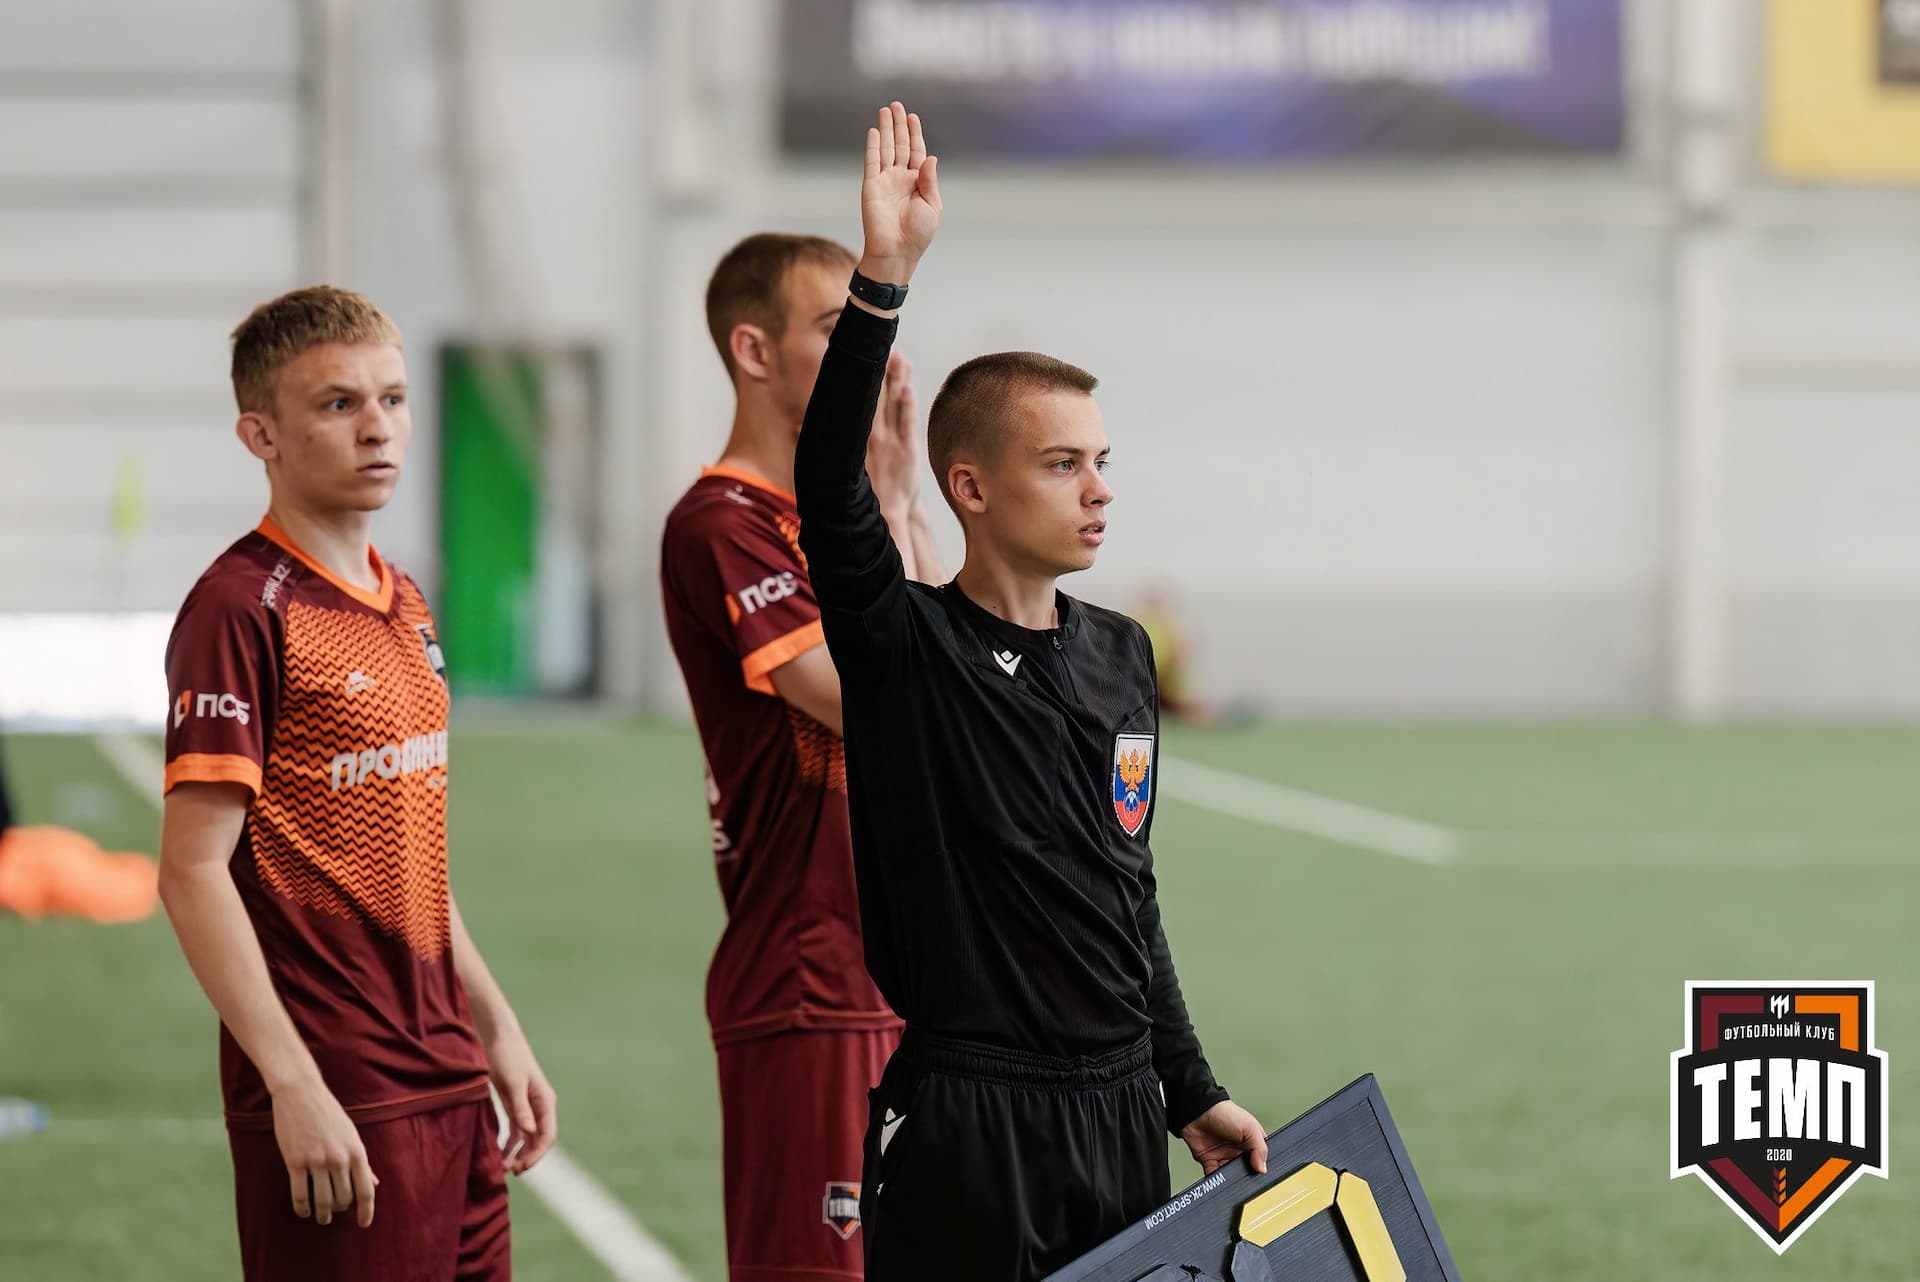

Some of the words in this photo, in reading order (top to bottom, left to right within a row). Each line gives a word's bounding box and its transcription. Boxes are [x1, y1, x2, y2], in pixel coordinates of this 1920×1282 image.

[739, 571, 798, 615] ПСБ
[196, 693, 251, 726] ПСБ
[1144, 1172, 1226, 1231] WWW.2K-SPORT.COM
